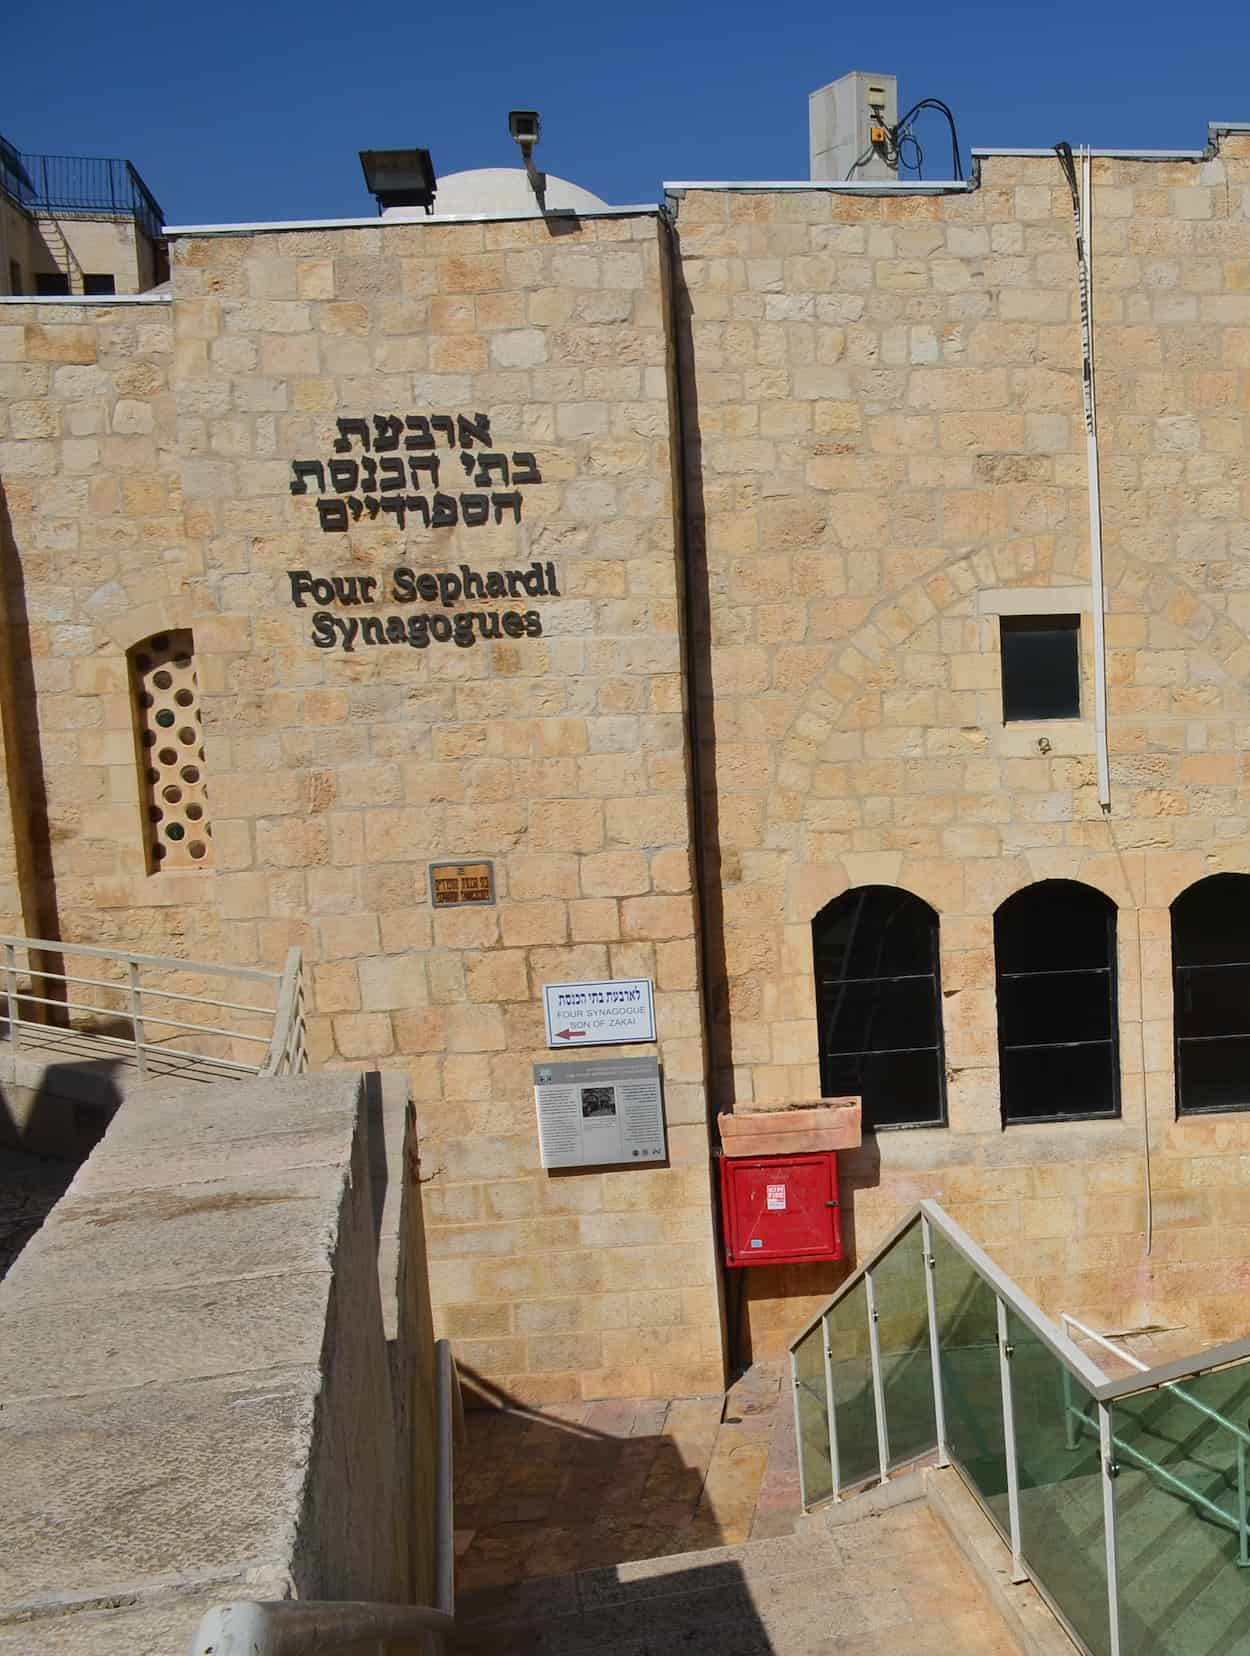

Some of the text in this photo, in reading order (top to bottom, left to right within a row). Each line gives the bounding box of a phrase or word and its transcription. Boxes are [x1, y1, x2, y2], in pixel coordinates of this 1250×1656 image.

[334, 413, 492, 453] ארבעת
[290, 451, 542, 496] בתי הכנסת
[316, 490, 522, 532] הספרדיים
[288, 562, 560, 607] Four Sephardi
[312, 609, 543, 652] Synagogues
[557, 1006, 646, 1018] FOUR SYNAGOGUE
[558, 986, 640, 1006] לארבעת בתי הכנסת
[570, 1018, 636, 1029] SON OF ZAKAI
